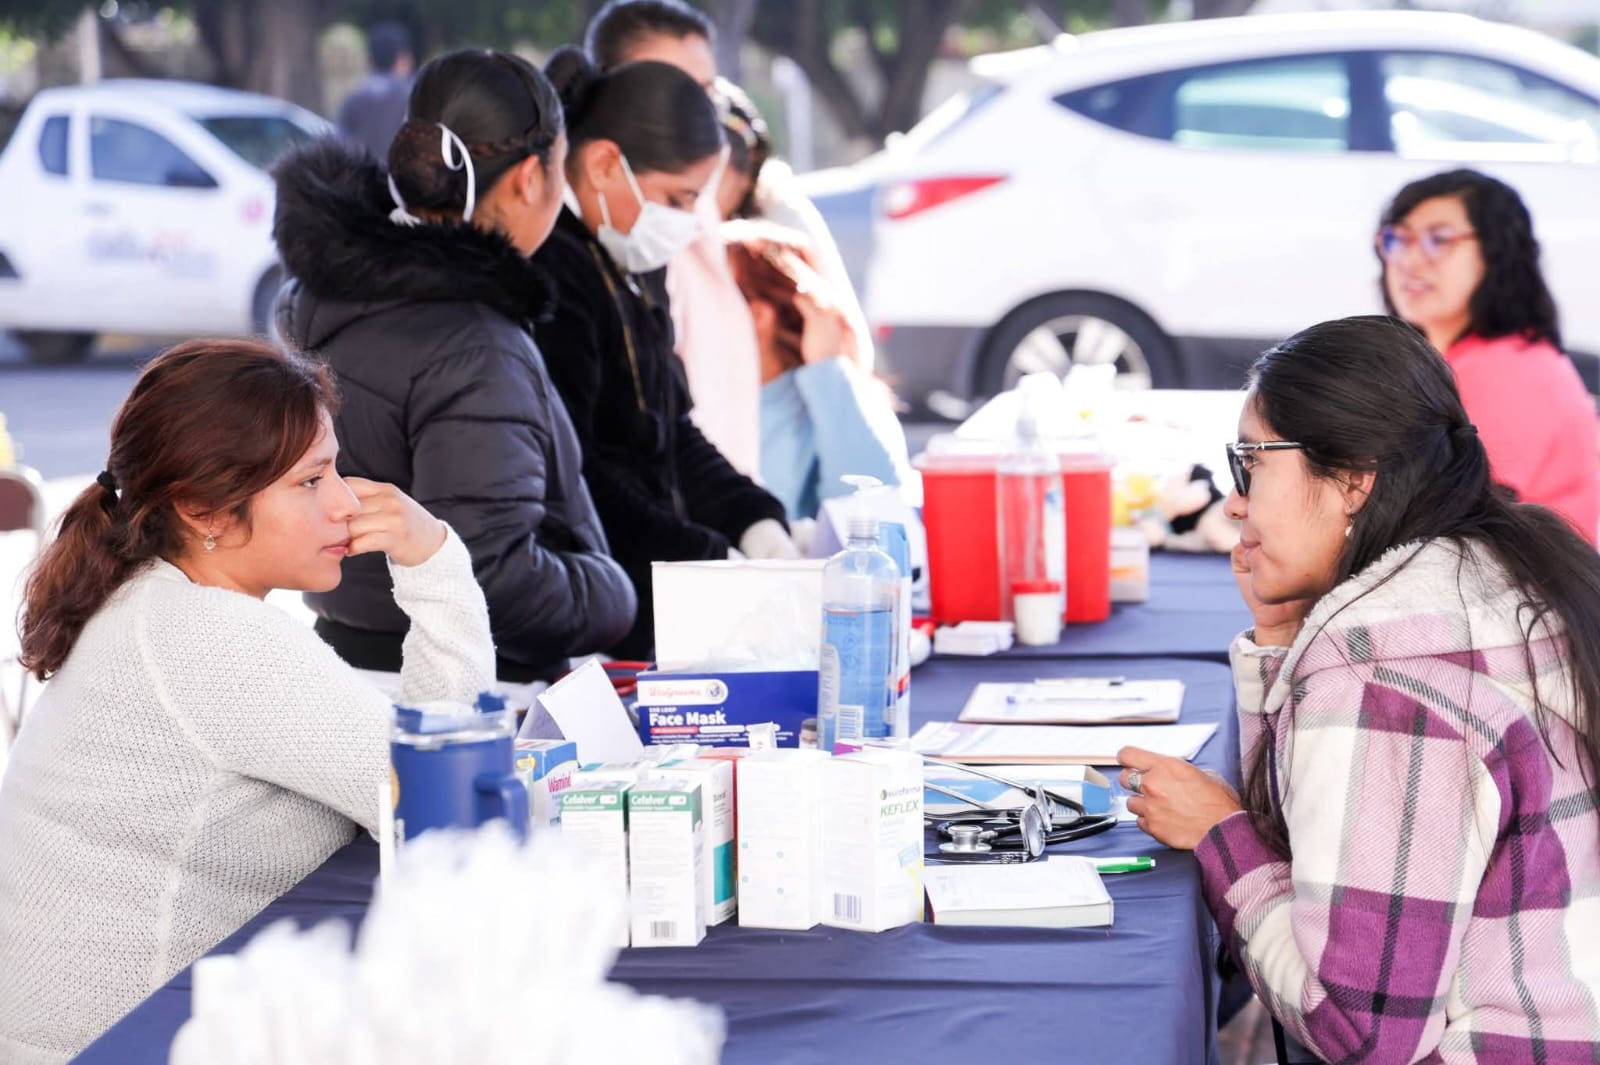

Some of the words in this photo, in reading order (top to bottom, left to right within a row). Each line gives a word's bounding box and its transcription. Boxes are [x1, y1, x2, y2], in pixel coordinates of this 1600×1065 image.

[650, 713, 684, 727] Face
[686, 710, 727, 726] Mask
[880, 799, 919, 818] KEFLEX
